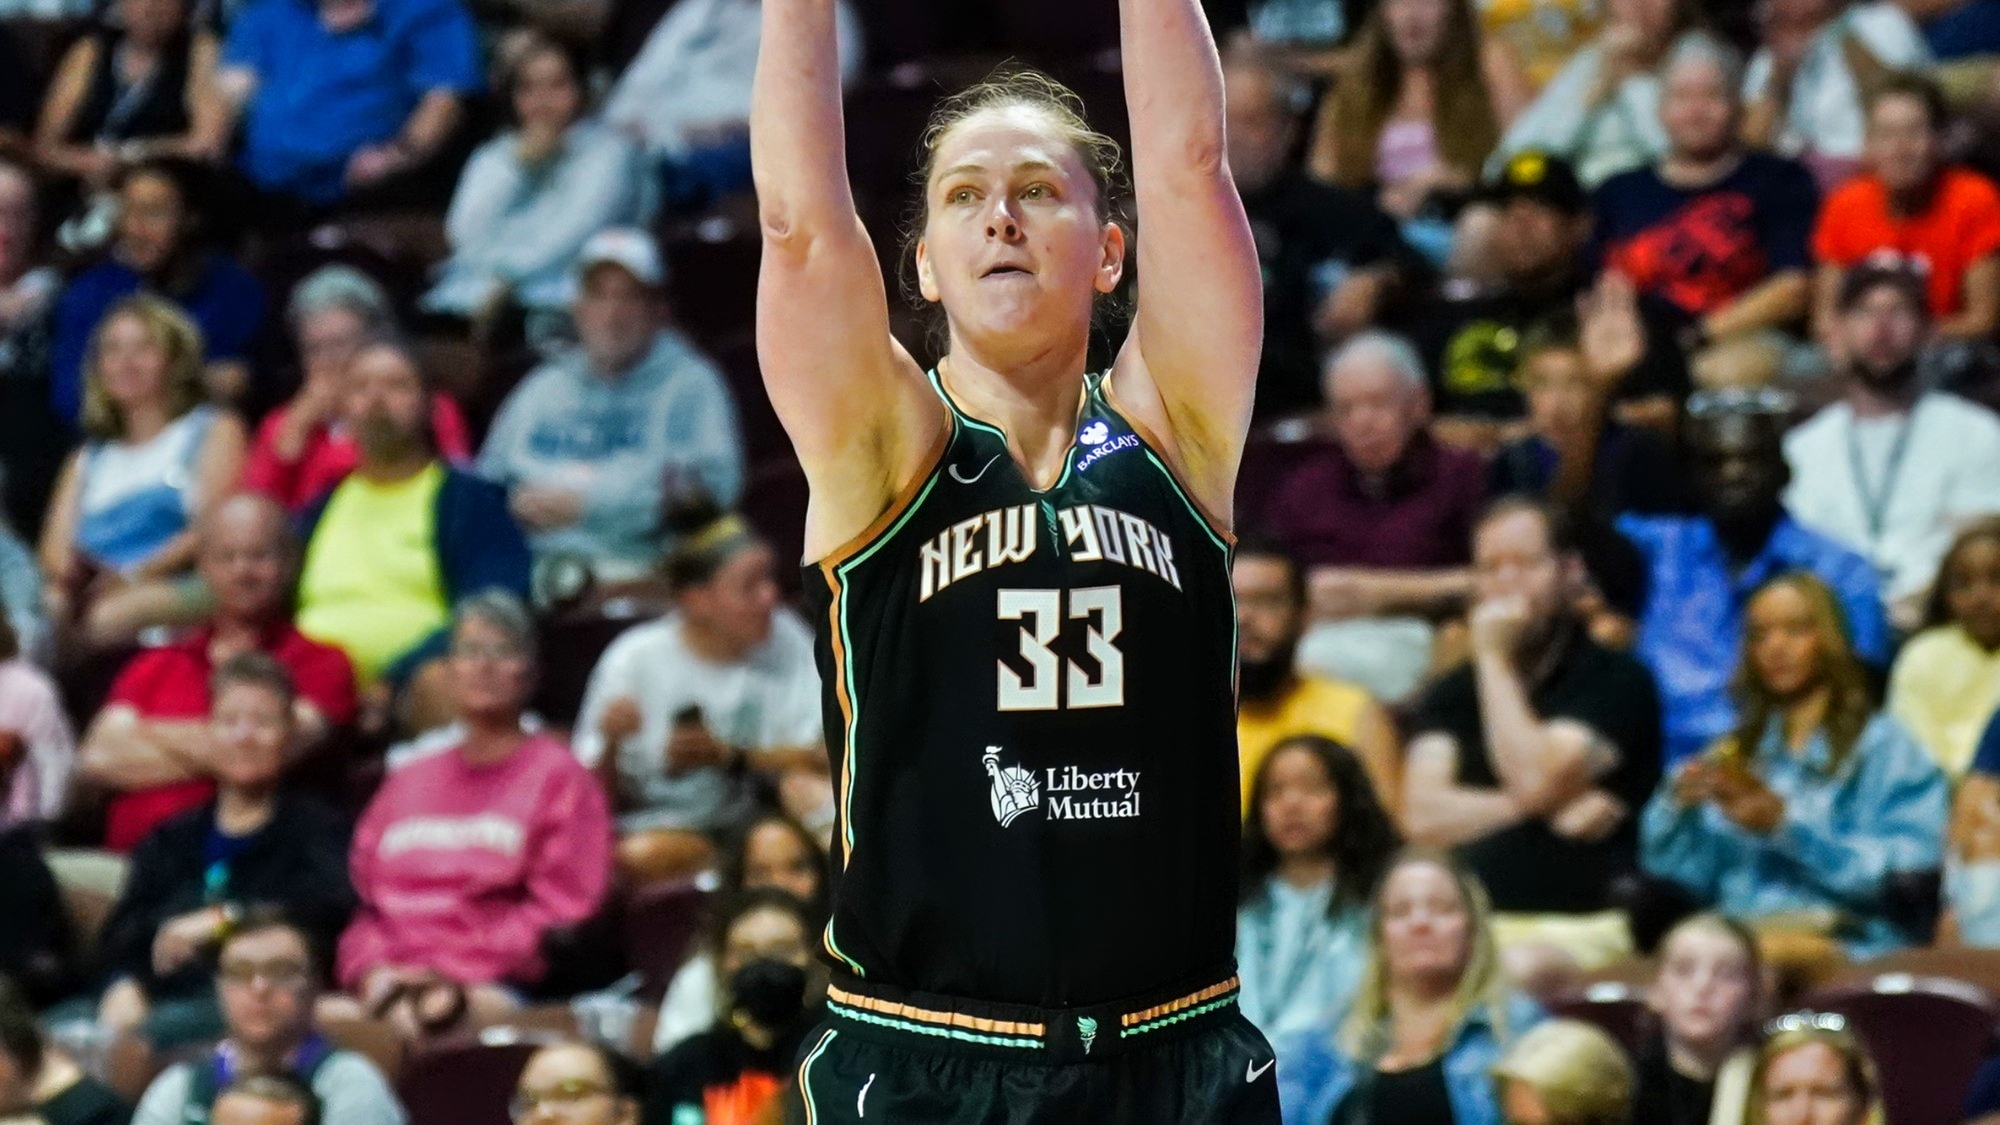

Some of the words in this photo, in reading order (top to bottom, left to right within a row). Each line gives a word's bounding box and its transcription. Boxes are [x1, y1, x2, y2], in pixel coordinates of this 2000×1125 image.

[1077, 434, 1139, 471] BARCLAYS
[919, 503, 1037, 603] NEW
[1057, 504, 1183, 592] YORK
[997, 585, 1124, 711] 33
[1046, 765, 1141, 799] Liberty
[1046, 792, 1141, 821] Mutual
